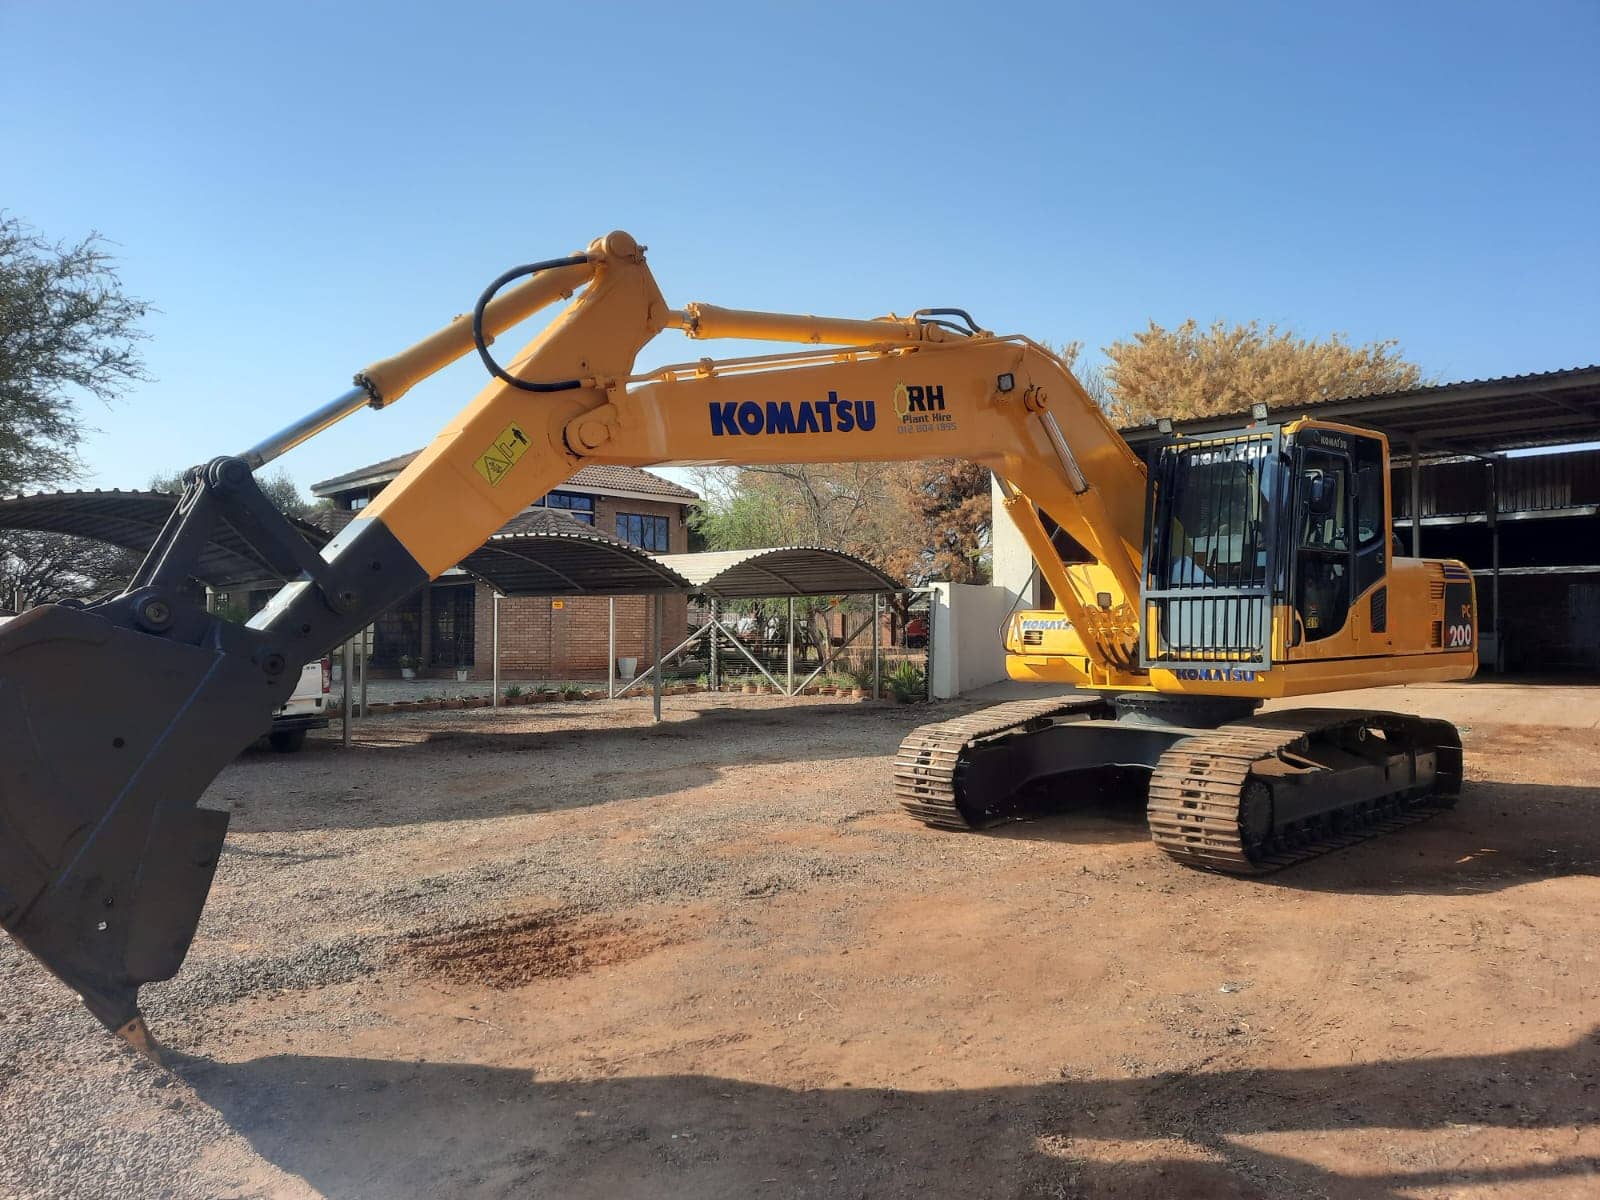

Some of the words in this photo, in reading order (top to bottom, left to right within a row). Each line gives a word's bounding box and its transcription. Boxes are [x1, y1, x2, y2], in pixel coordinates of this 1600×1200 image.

[709, 391, 877, 436] KOMATSU
[902, 414, 929, 424] Plant
[932, 412, 952, 422] Hire
[1320, 436, 1348, 449] KOMATSU
[1461, 603, 1471, 618] PC
[1449, 623, 1472, 647] 200
